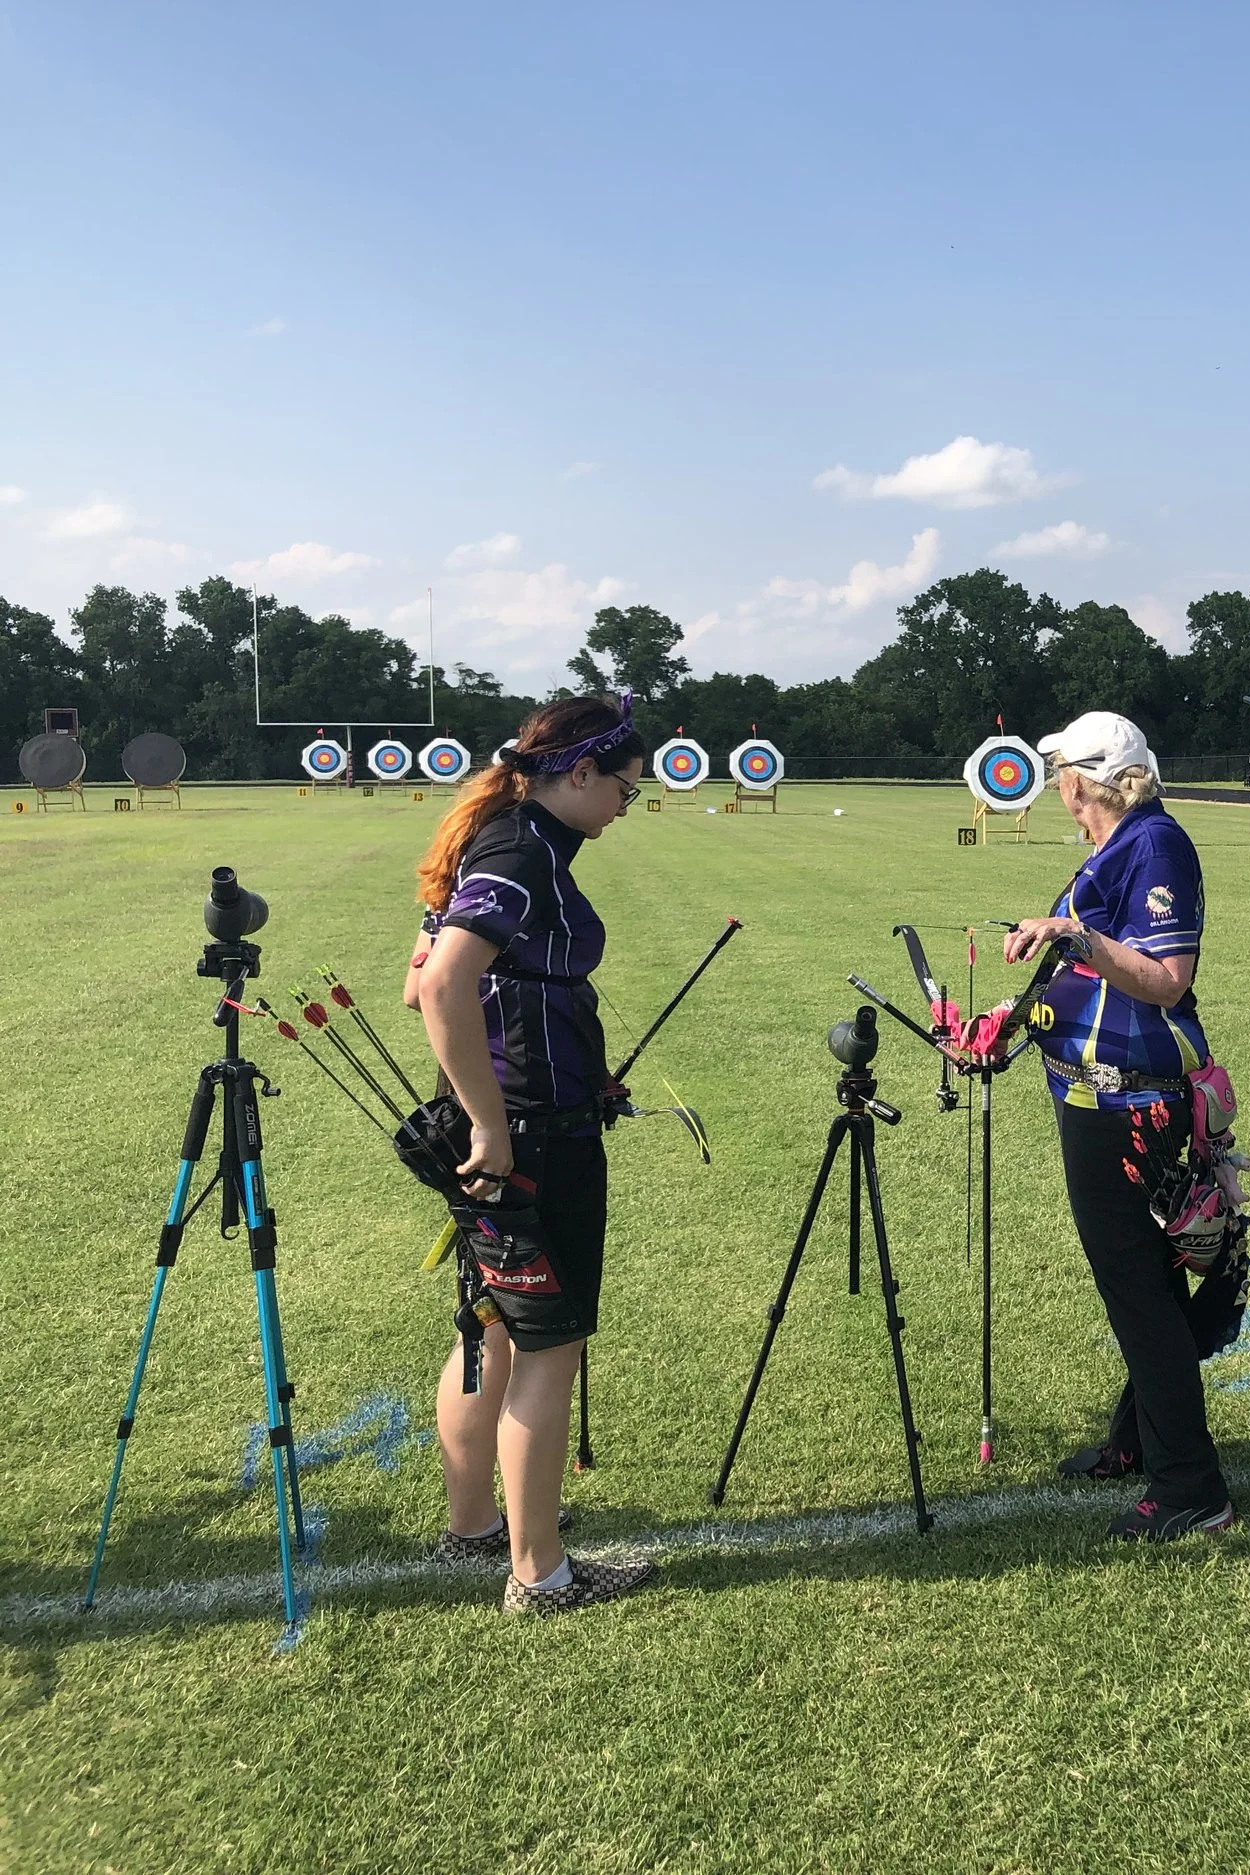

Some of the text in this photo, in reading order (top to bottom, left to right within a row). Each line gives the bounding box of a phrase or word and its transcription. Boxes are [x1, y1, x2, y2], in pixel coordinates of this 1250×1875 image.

[299, 788, 307, 796] 11
[414, 793, 423, 801] 13
[16, 803, 23, 813] 9
[117, 800, 130, 811] 10
[649, 801, 660, 811] 16
[725, 804, 735, 813] 17
[959, 830, 975, 845] 18
[1149, 918, 1180, 928] OKLAHOMA
[244, 1103, 258, 1146] ZOMEI
[496, 1273, 547, 1284] EASTON
